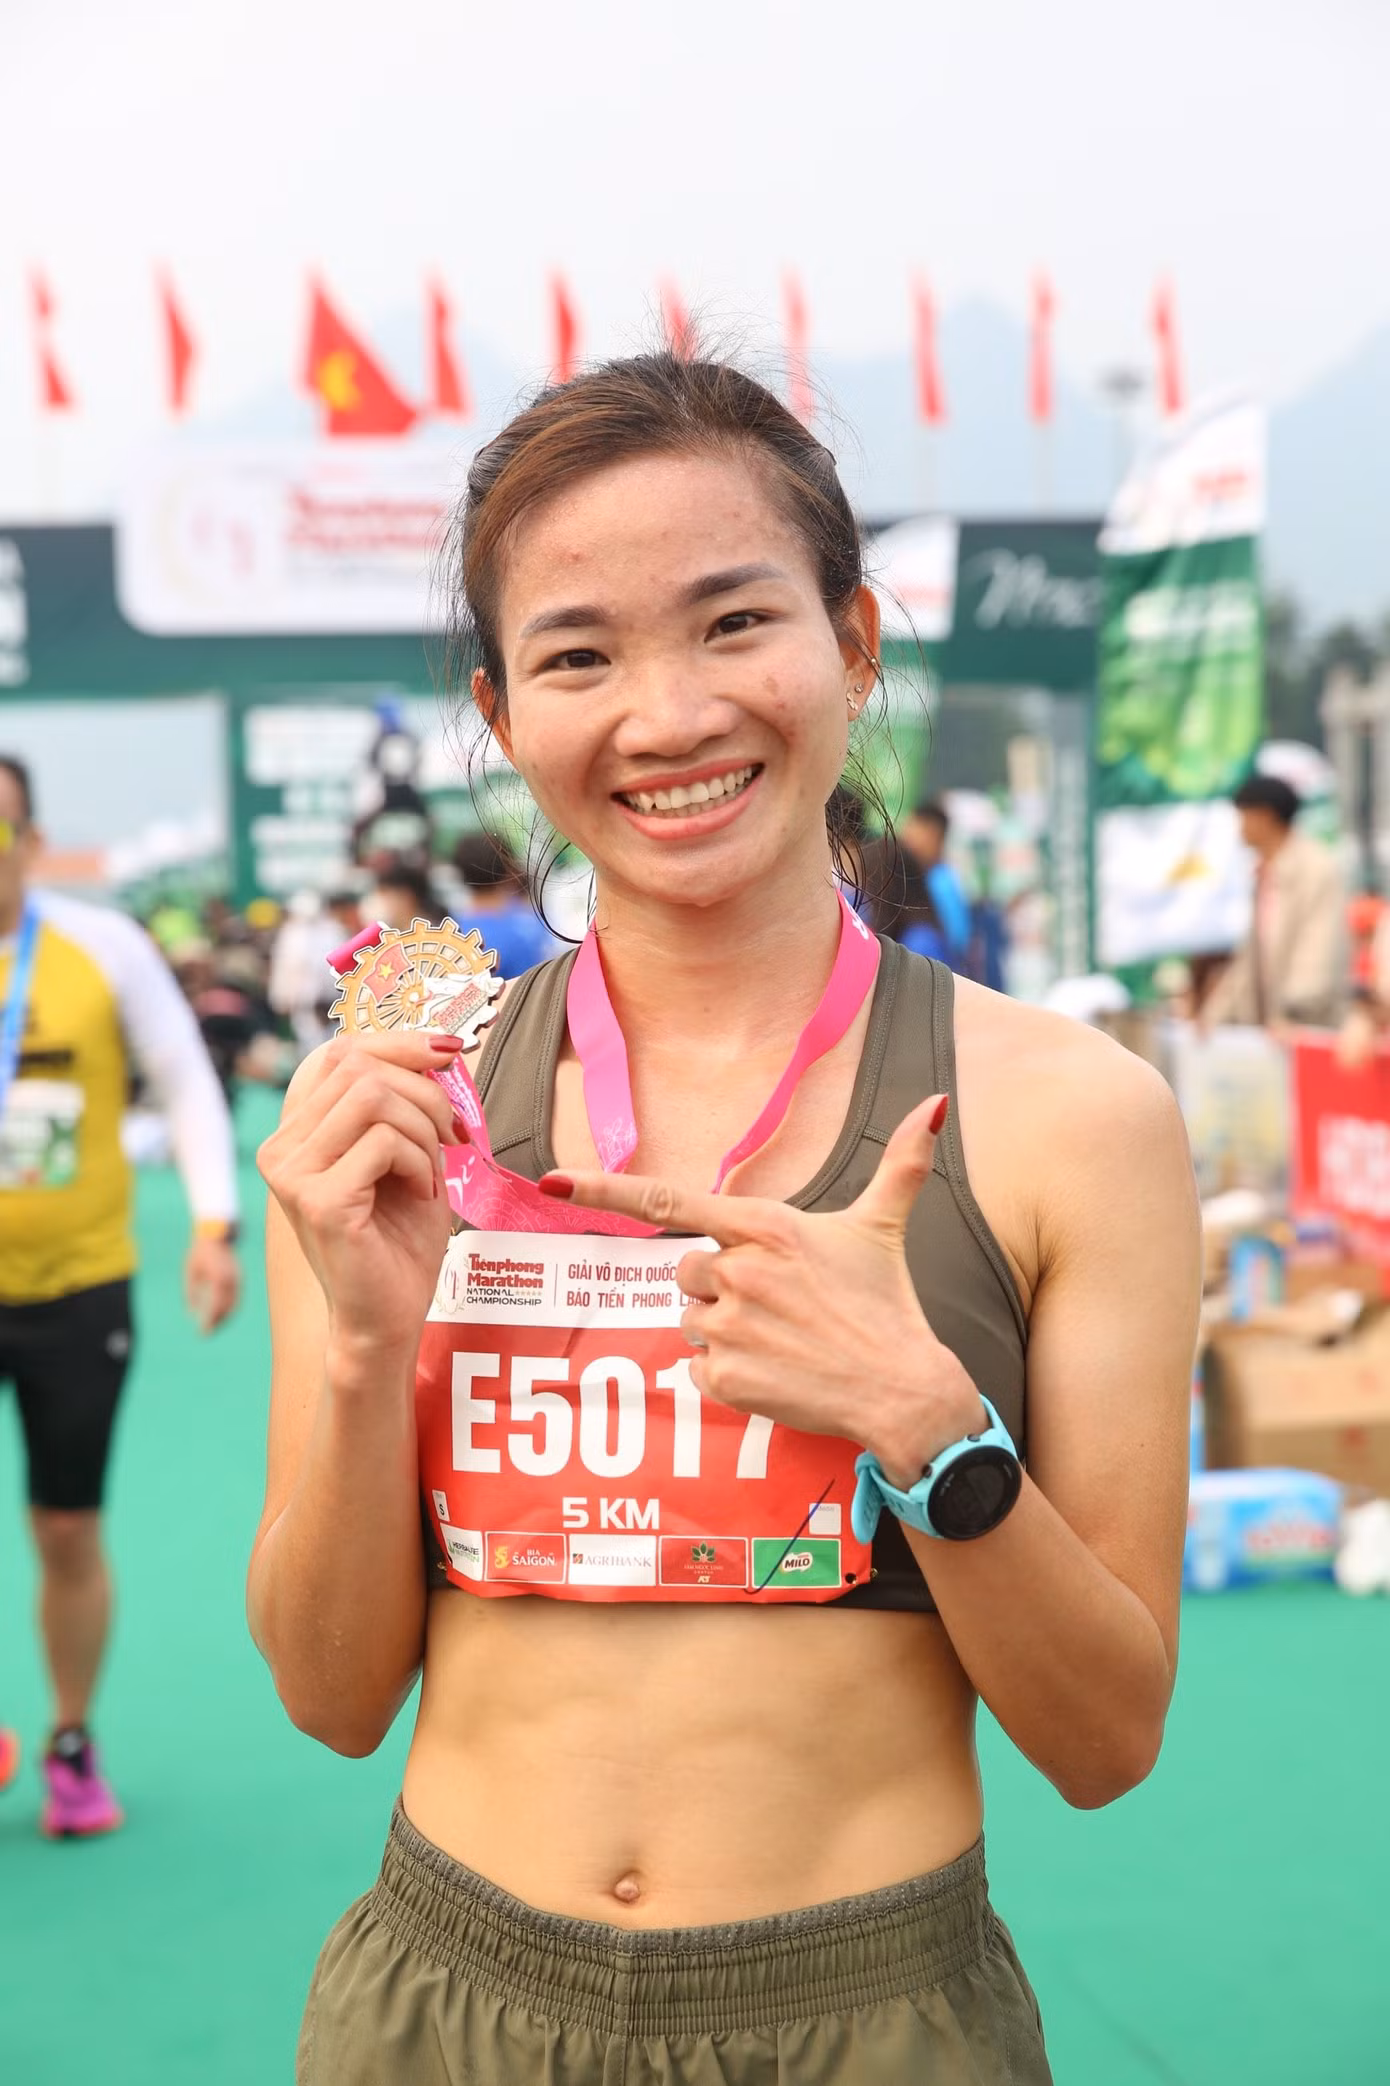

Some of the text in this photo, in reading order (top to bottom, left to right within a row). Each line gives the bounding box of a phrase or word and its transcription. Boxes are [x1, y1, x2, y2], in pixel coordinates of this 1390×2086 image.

[467, 1272, 544, 1289] Marathon
[595, 1262, 611, 1281] VÔ
[614, 1266, 642, 1286] ĐỊCH
[466, 1288, 514, 1297] NATIONAL
[566, 1287, 590, 1307] BÁO
[632, 1292, 672, 1308] PHONG
[466, 1296, 542, 1306] CHAMPIONSHIP
[439, 1503, 445, 1516] S
[562, 1497, 660, 1530] 5 KM
[585, 1554, 652, 1568] AGRIBANK
[785, 1558, 810, 1569] MILO
